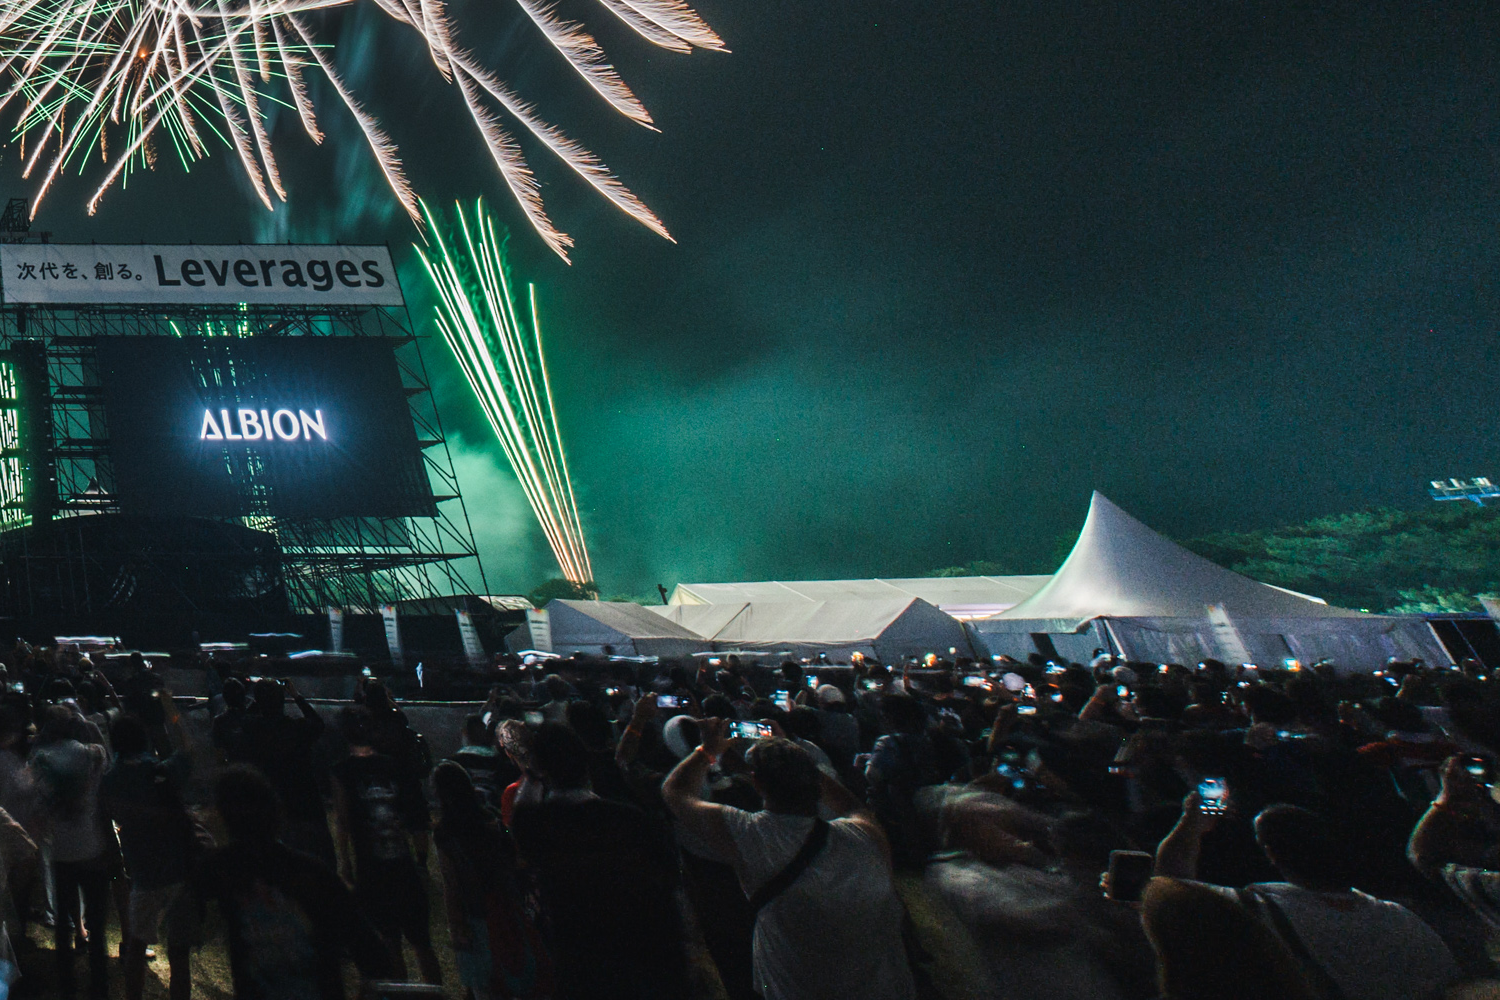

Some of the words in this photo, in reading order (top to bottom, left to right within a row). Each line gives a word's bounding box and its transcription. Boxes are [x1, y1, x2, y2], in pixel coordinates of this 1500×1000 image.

[16, 260, 143, 281] 次代を、創る。
[153, 255, 385, 291] Leverages
[200, 409, 327, 441] ALBION
